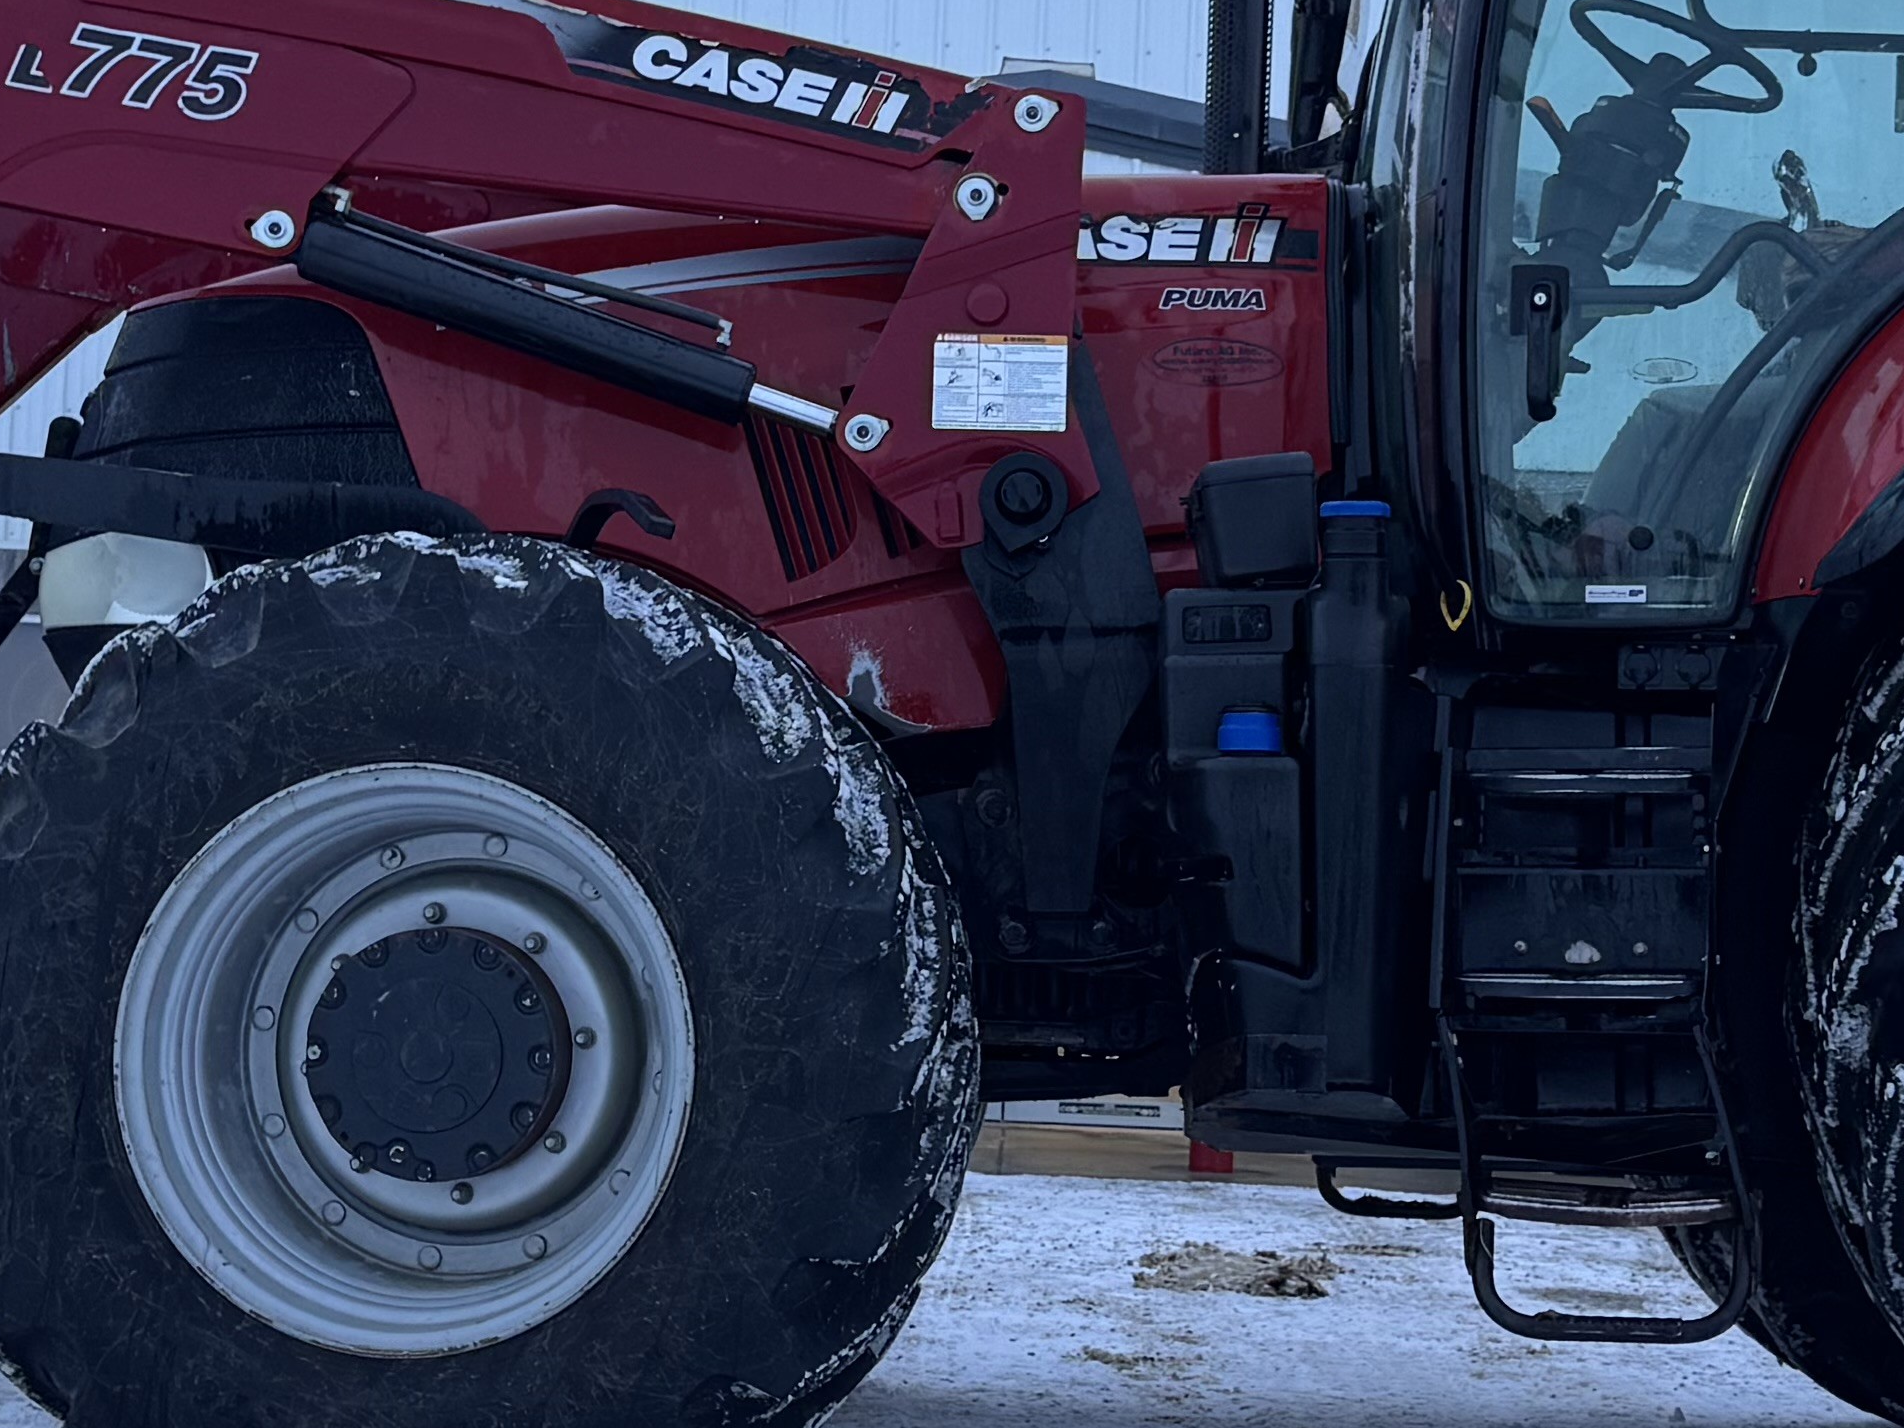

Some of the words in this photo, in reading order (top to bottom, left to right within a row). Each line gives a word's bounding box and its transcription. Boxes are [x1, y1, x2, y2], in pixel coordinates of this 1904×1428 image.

[4, 22, 260, 121] L775
[632, 35, 837, 117] CASE
[1158, 287, 1267, 311] PUMA
